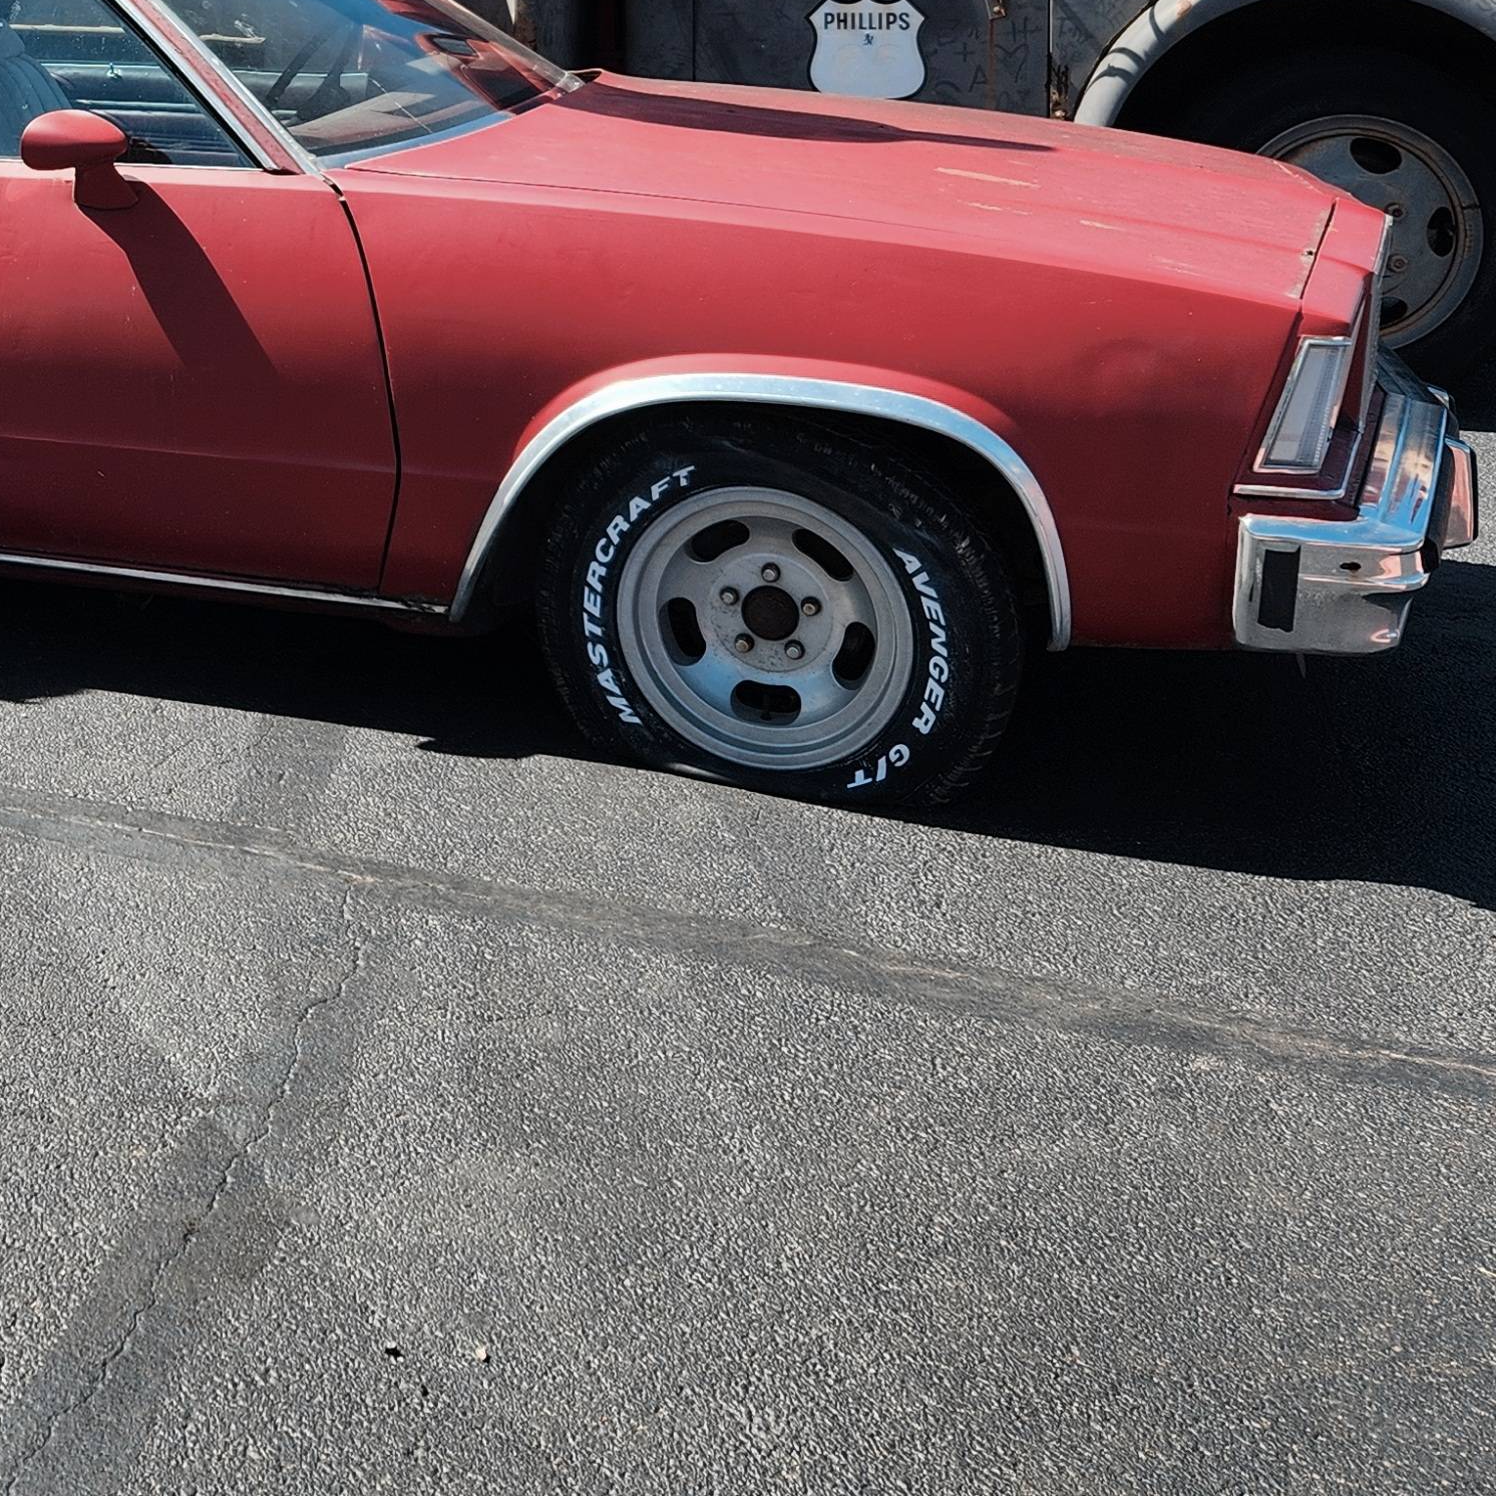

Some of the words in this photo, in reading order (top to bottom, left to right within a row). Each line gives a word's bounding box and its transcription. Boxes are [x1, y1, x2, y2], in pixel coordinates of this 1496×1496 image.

[824, 12, 911, 31] PHILLIPS
[582, 465, 695, 726] MASTERCRAFT
[892, 547, 948, 735] AVENGER
[847, 744, 910, 789] G/T
